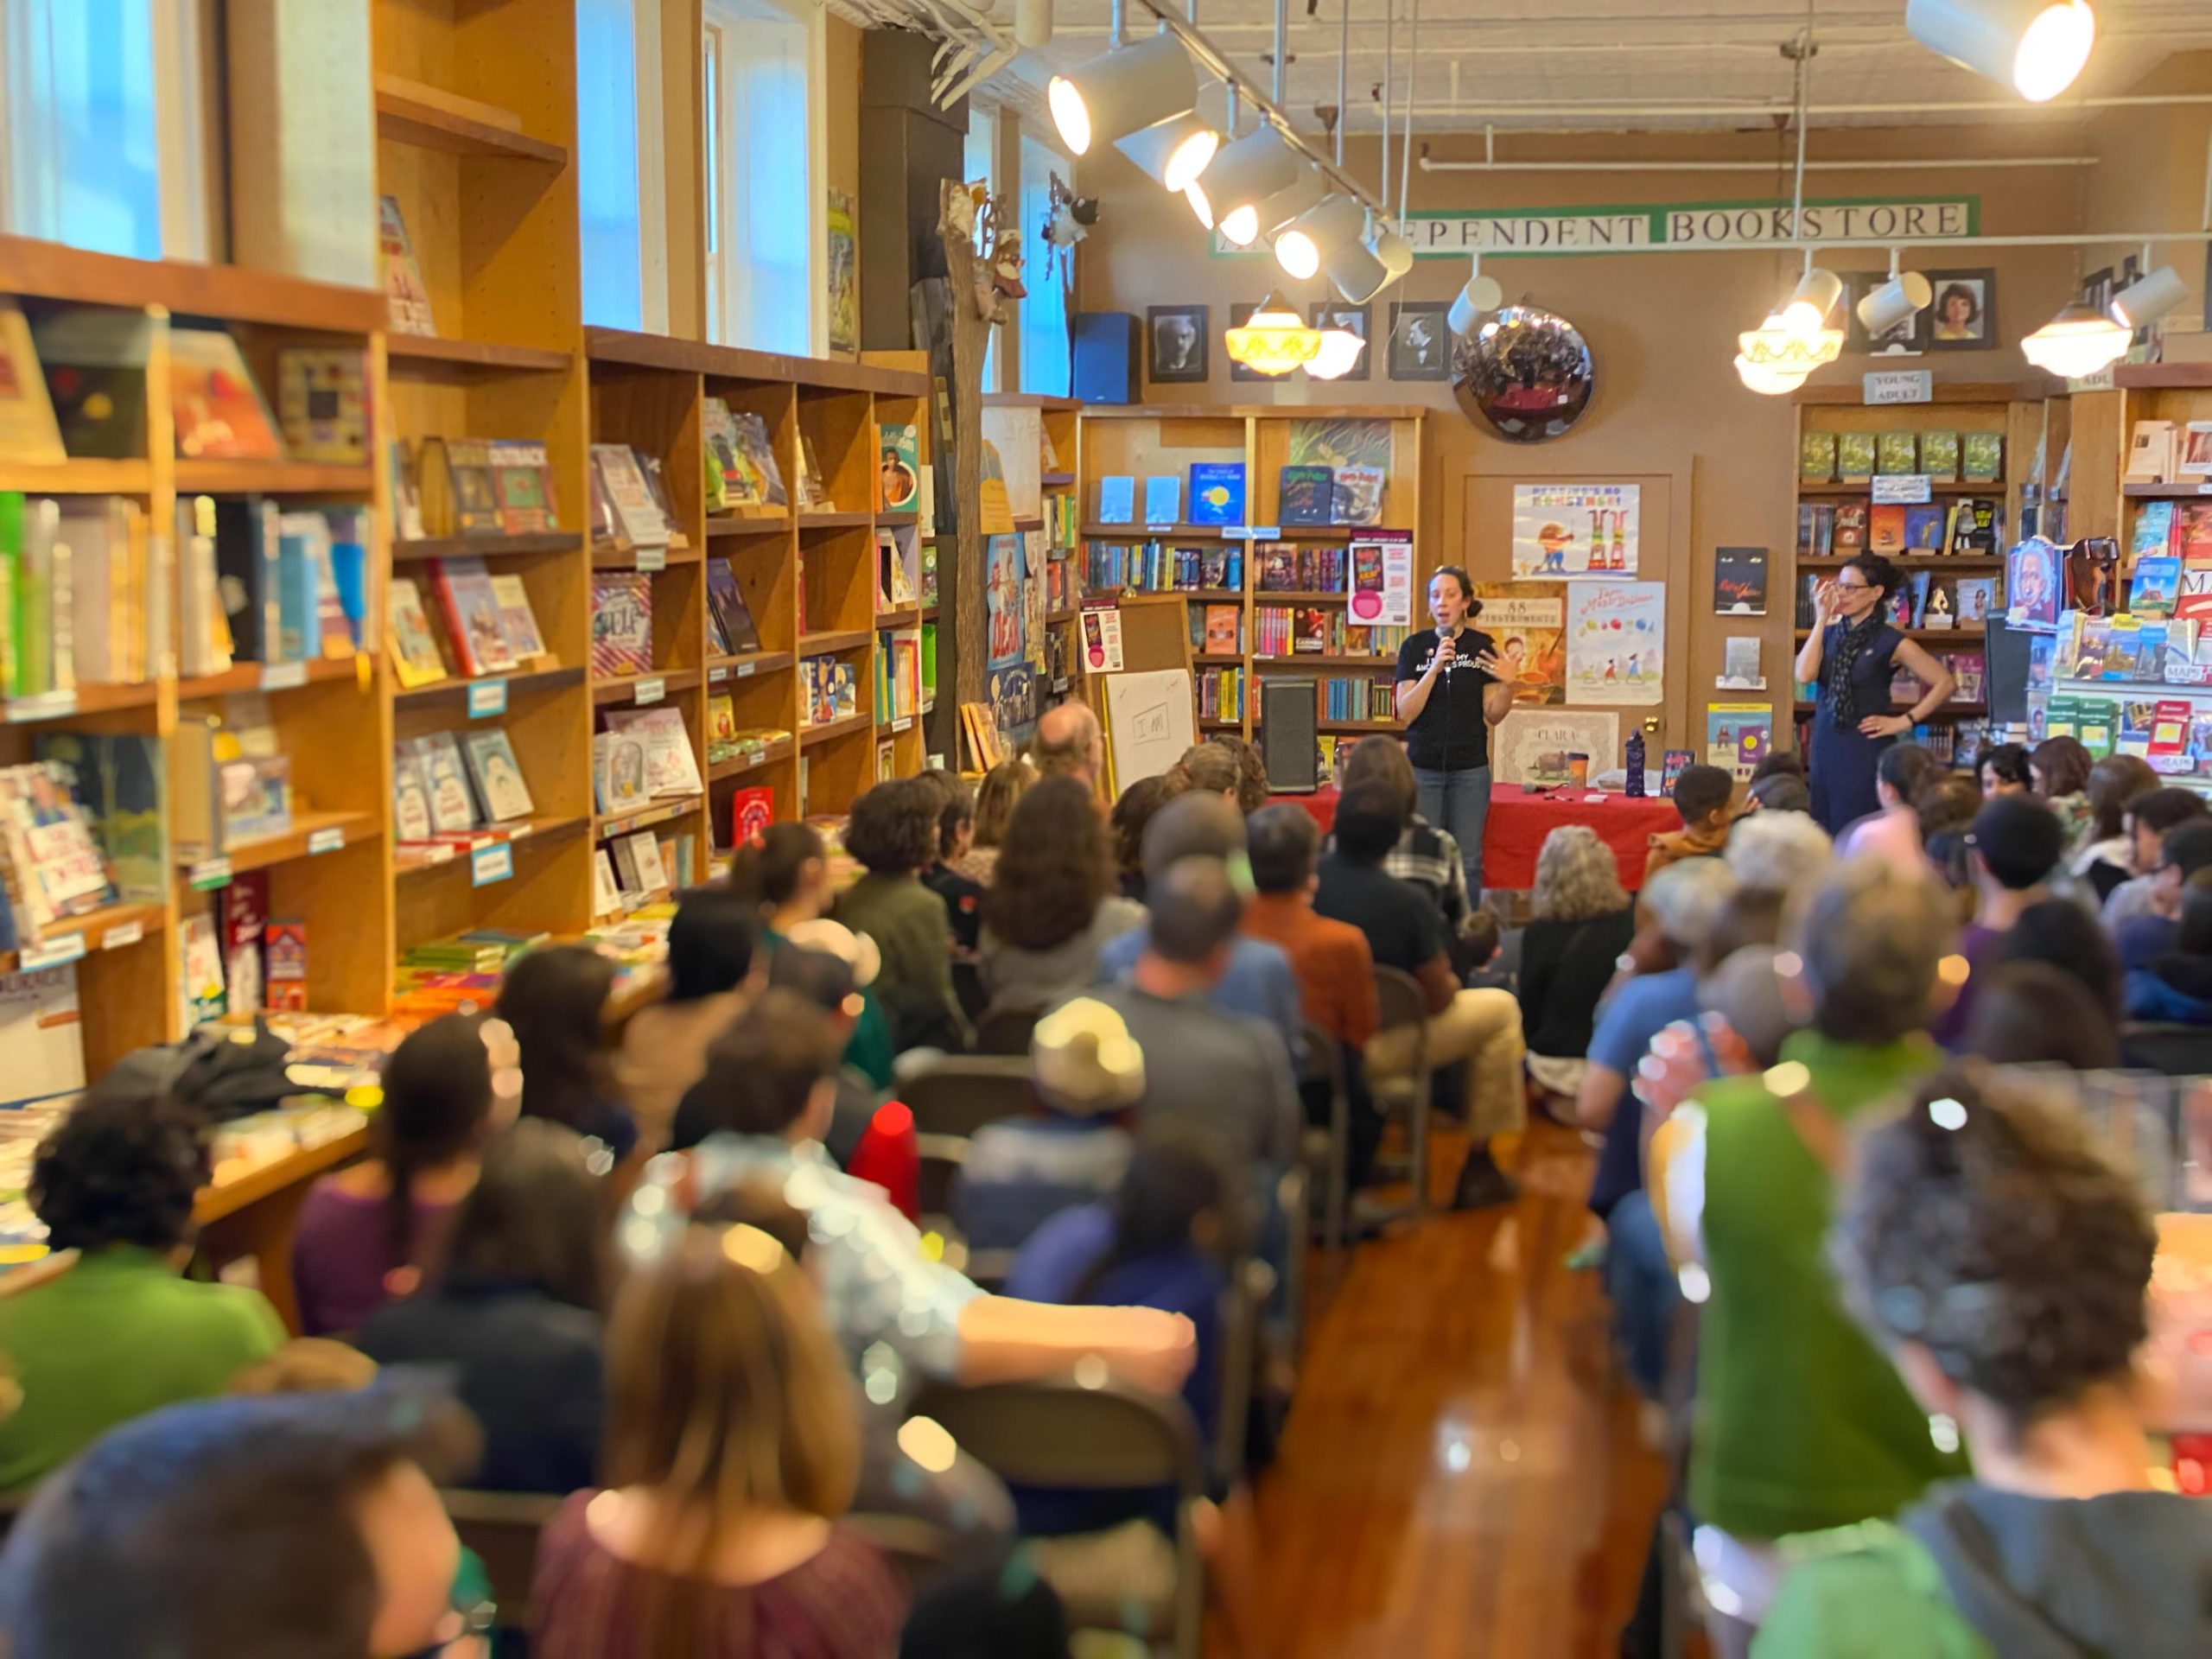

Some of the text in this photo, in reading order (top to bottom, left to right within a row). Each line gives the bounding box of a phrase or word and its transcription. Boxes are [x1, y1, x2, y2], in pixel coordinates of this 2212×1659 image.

[1672, 206, 1960, 242] BOOKSTORE
[1875, 374, 1919, 385] YOUNG
[1878, 389, 1917, 399] ADULT
[1508, 601, 1526, 613] 88
[2167, 666, 2200, 678] MAPS
[1538, 730, 1576, 741] CLARA
